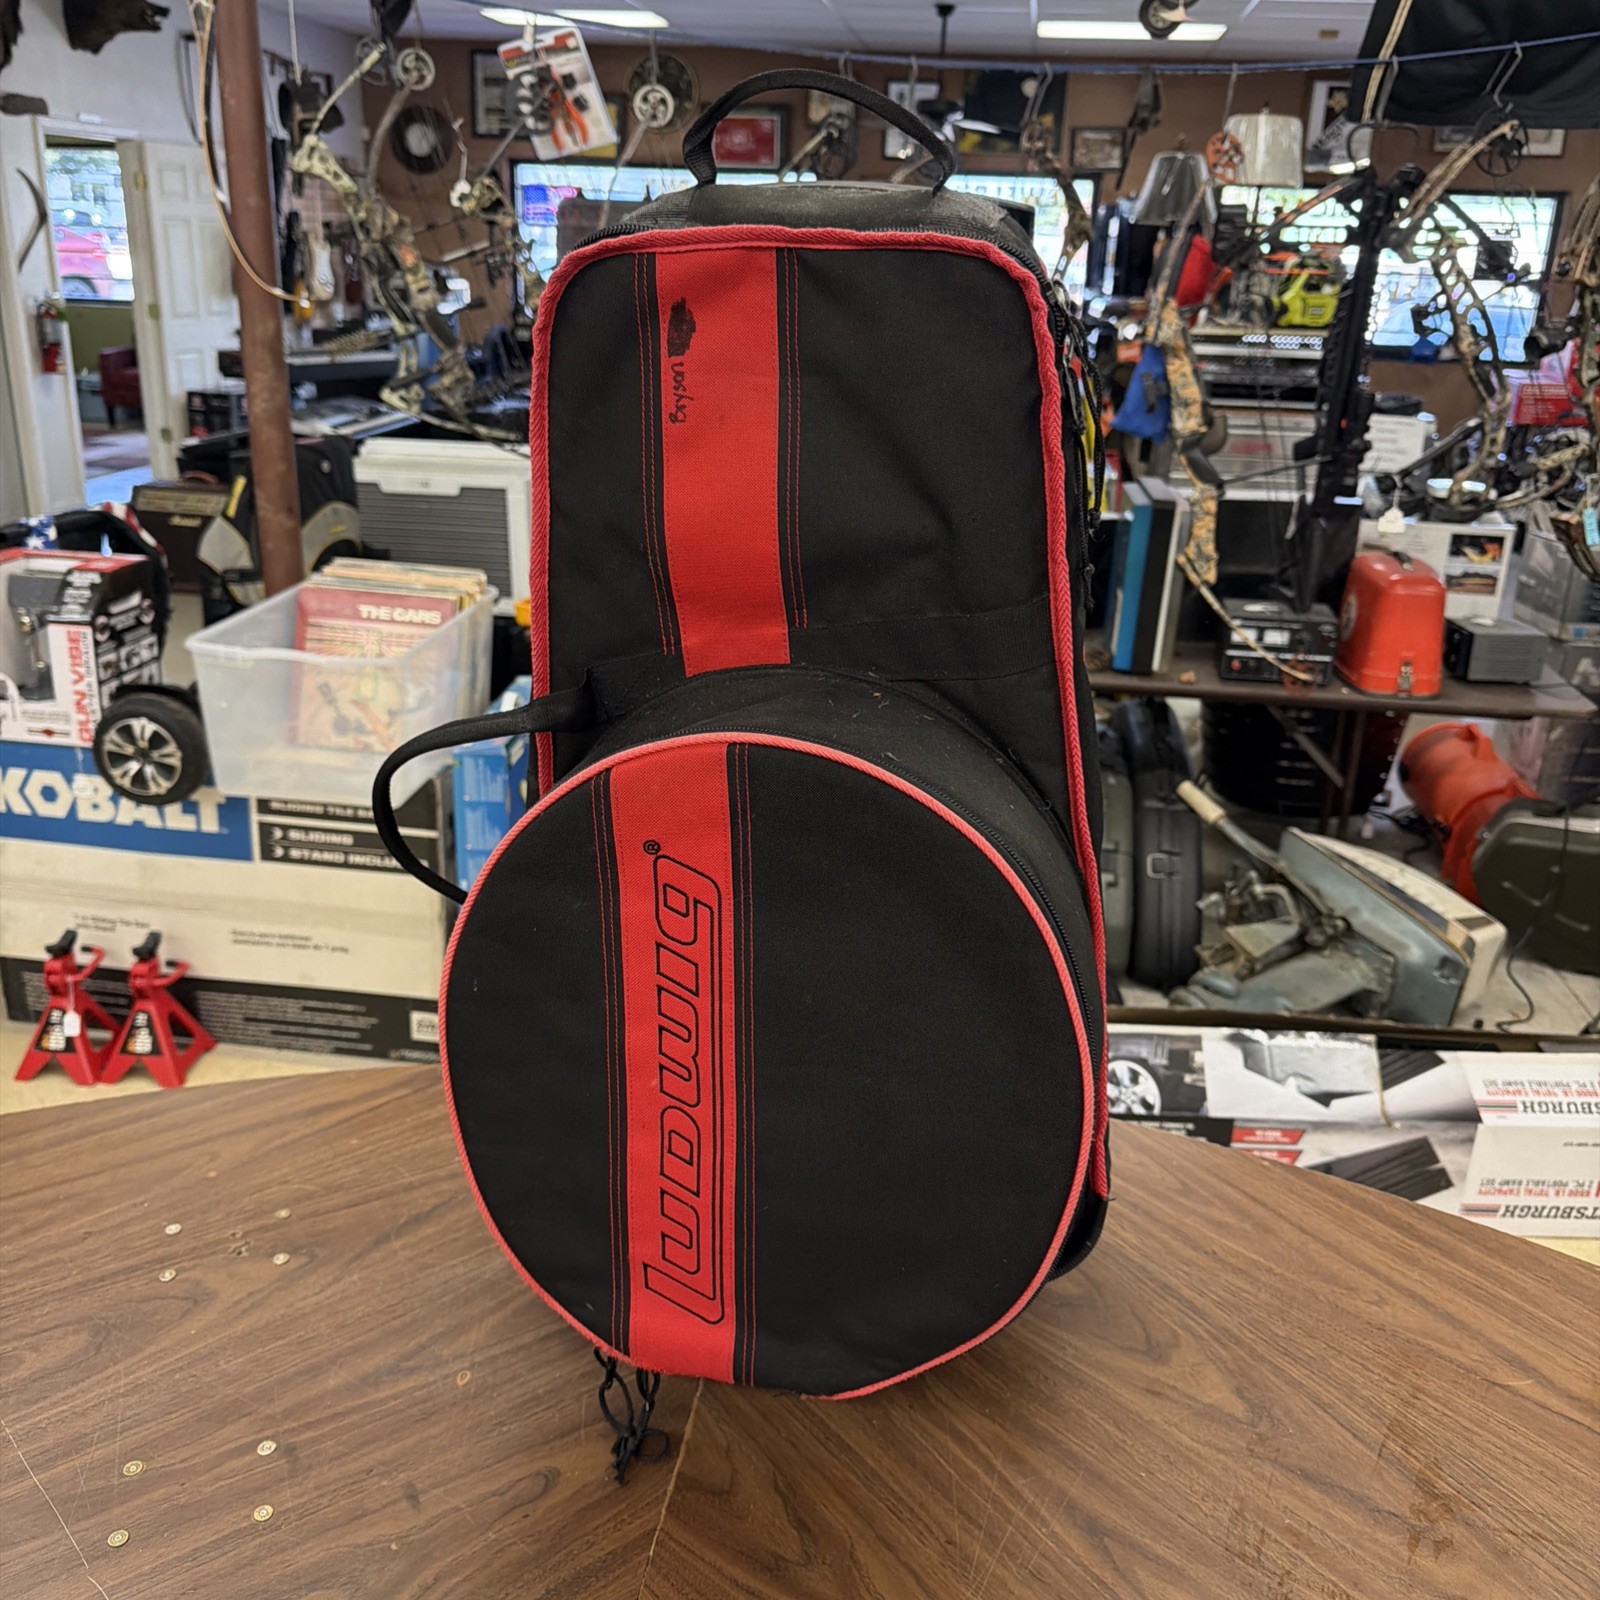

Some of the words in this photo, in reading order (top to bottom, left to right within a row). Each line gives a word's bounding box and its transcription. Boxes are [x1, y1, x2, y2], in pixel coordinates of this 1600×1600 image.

[668, 362, 694, 424] Bryson
[357, 604, 391, 620] THE
[393, 607, 441, 624] CARS
[0, 767, 220, 834] KOBALT
[286, 828, 354, 846] SLIDING
[288, 848, 345, 864] STAND
